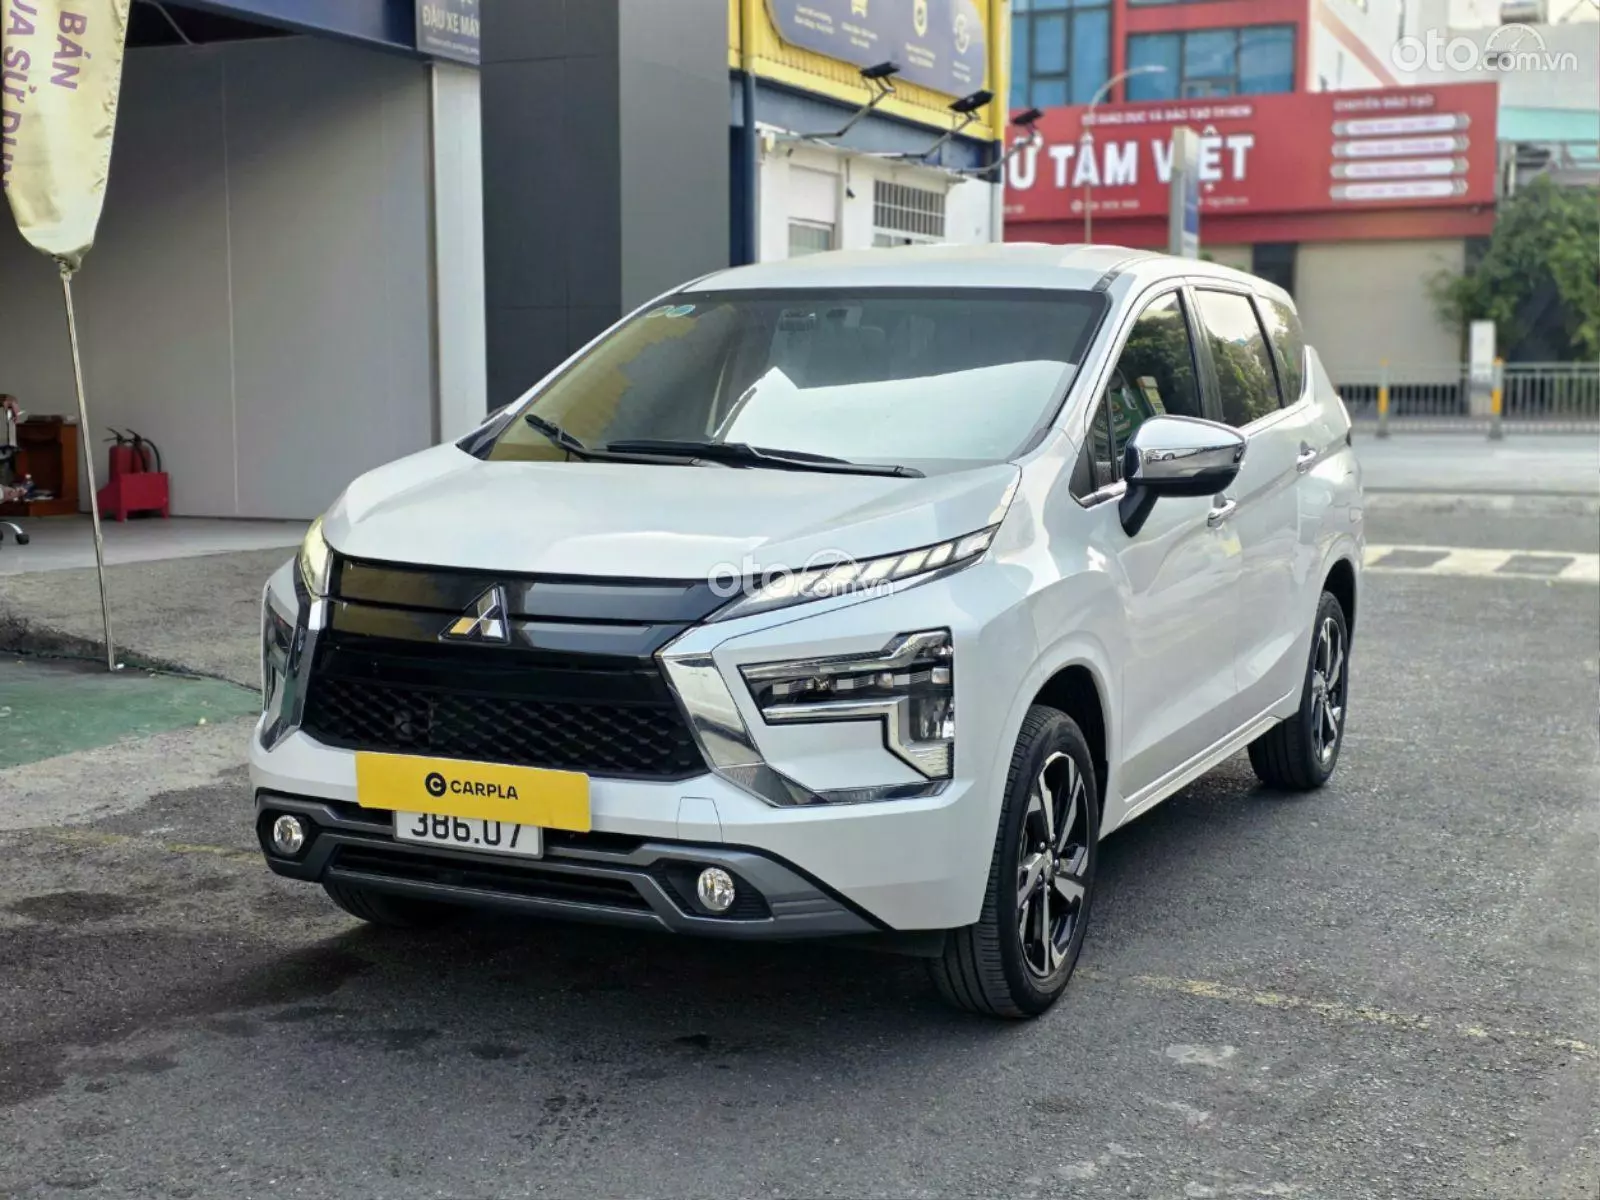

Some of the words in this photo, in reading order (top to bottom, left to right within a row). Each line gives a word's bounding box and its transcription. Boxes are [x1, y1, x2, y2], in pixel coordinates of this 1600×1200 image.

[446, 11, 459, 34] XE
[50, 10, 91, 90] BÁN
[1048, 131, 1138, 188] TÂM
[1151, 124, 1255, 194] VỆT
[450, 779, 519, 801] CARPLA
